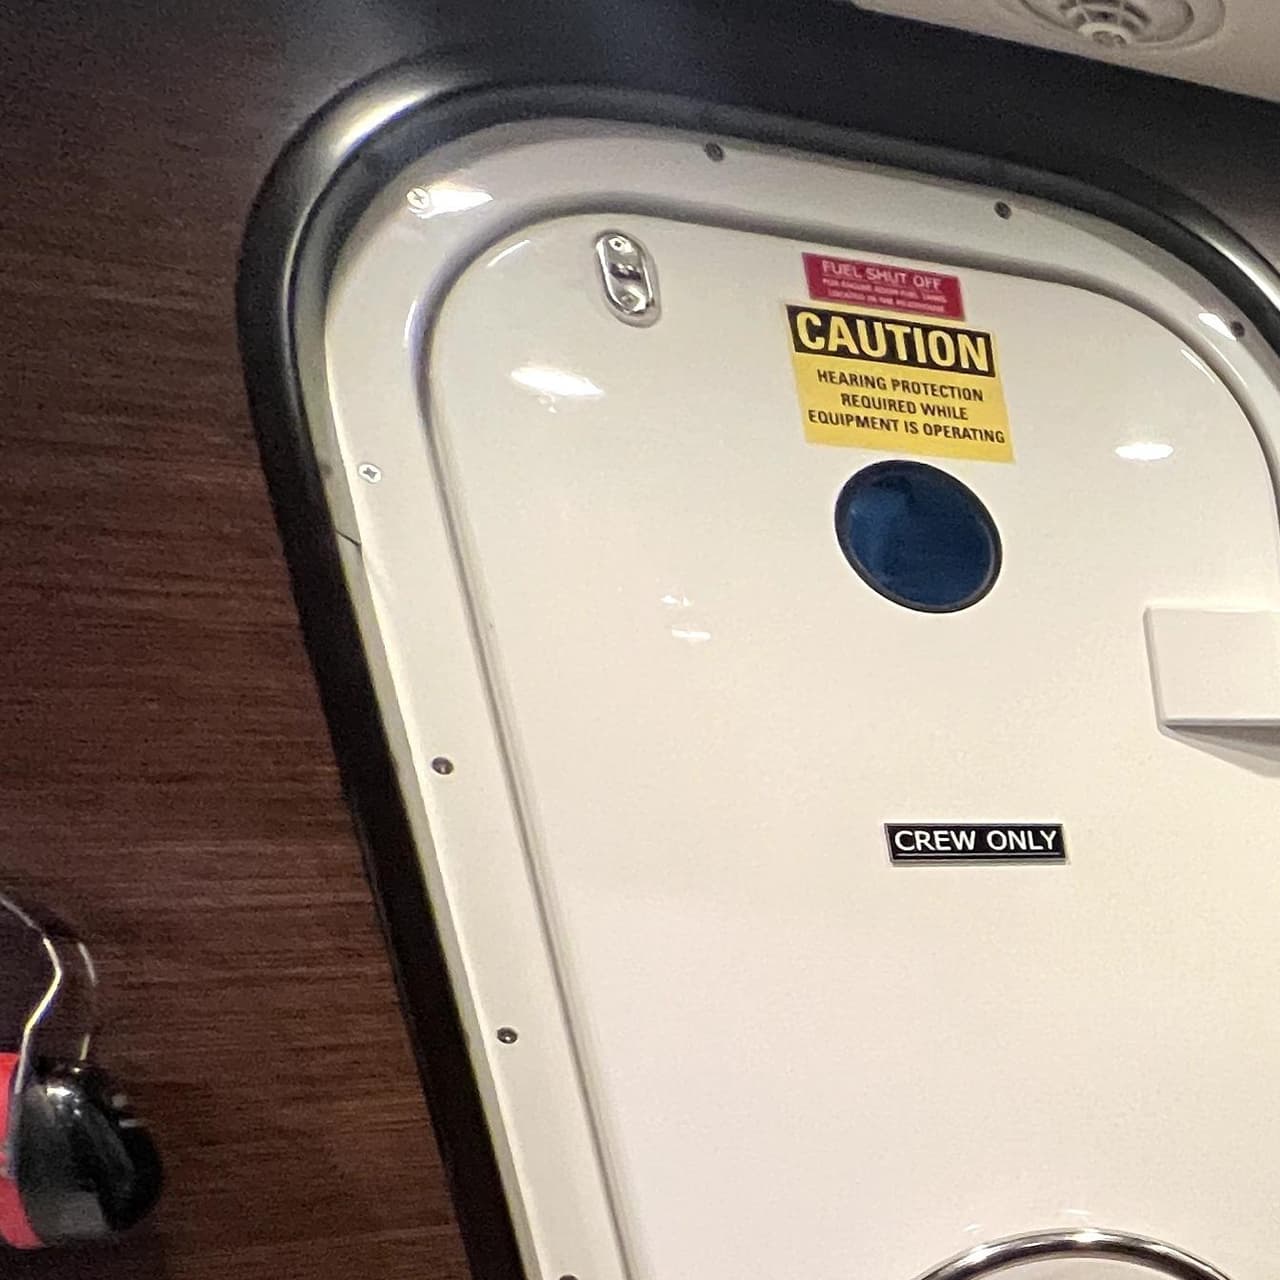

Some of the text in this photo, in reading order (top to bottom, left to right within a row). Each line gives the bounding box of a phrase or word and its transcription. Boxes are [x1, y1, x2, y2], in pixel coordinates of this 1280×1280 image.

[821, 260, 943, 291] FUEL SHUT OFF
[796, 310, 989, 373] CAUTION
[817, 368, 984, 402] HEARING PROTECTION
[840, 392, 969, 421] REQUIRED WHILE
[808, 409, 1005, 444] EQUIPMENT IS OPERATING
[894, 830, 1057, 851] CREW ONLY
